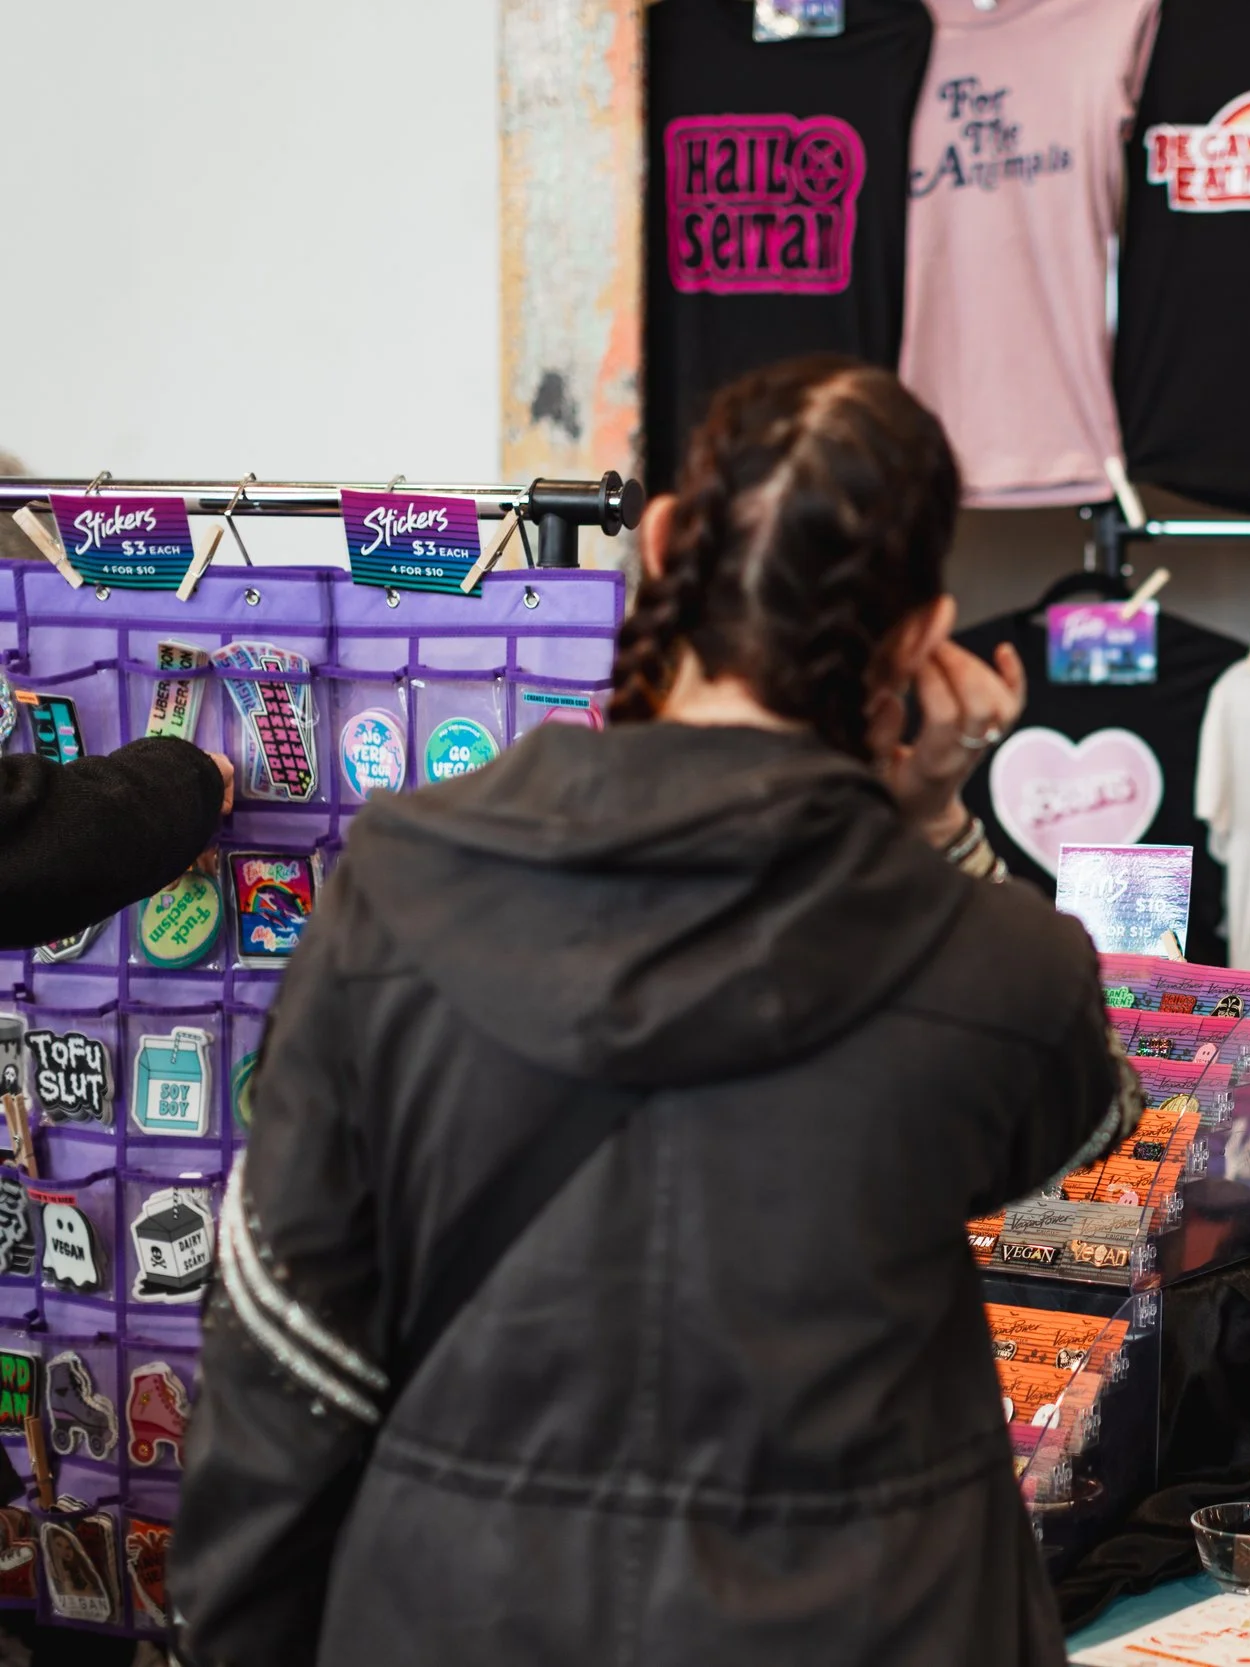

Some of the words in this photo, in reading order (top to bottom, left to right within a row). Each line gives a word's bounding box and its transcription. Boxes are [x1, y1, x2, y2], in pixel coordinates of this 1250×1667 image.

[938, 76, 1009, 119] For
[74, 505, 157, 556] Stickers
[360, 503, 448, 556] Stickers
[121, 540, 147, 556] $3
[150, 546, 181, 556] EACH
[412, 540, 436, 557] $3
[440, 547, 469, 559] EACH
[102, 565, 110, 574] 4
[112, 565, 133, 575] FOR
[137, 566, 156, 575] $10
[390, 565, 397, 574] 4
[400, 565, 422, 576] FOR
[425, 567, 444, 577] $10
[153, 644, 175, 720] LIBERTION
[171, 650, 193, 728] LIBERAON
[449, 746, 471, 762] GO
[432, 761, 487, 779] VEGA
[148, 883, 208, 944] Fascism
[171, 905, 211, 946] Fuck
[1130, 926, 1152, 938] $15
[29, 1034, 102, 1070] TOFU
[38, 1070, 104, 1111] SLUT
[160, 1083, 191, 1100] SOY
[159, 1101, 190, 1118] BOY
[51, 1237, 85, 1261] VEGAN
[179, 1233, 202, 1252] DAIRY
[967, 1235, 995, 1247] GAN
[183, 1253, 206, 1271] SCARY
[1003, 1244, 1055, 1264] VEGAN
